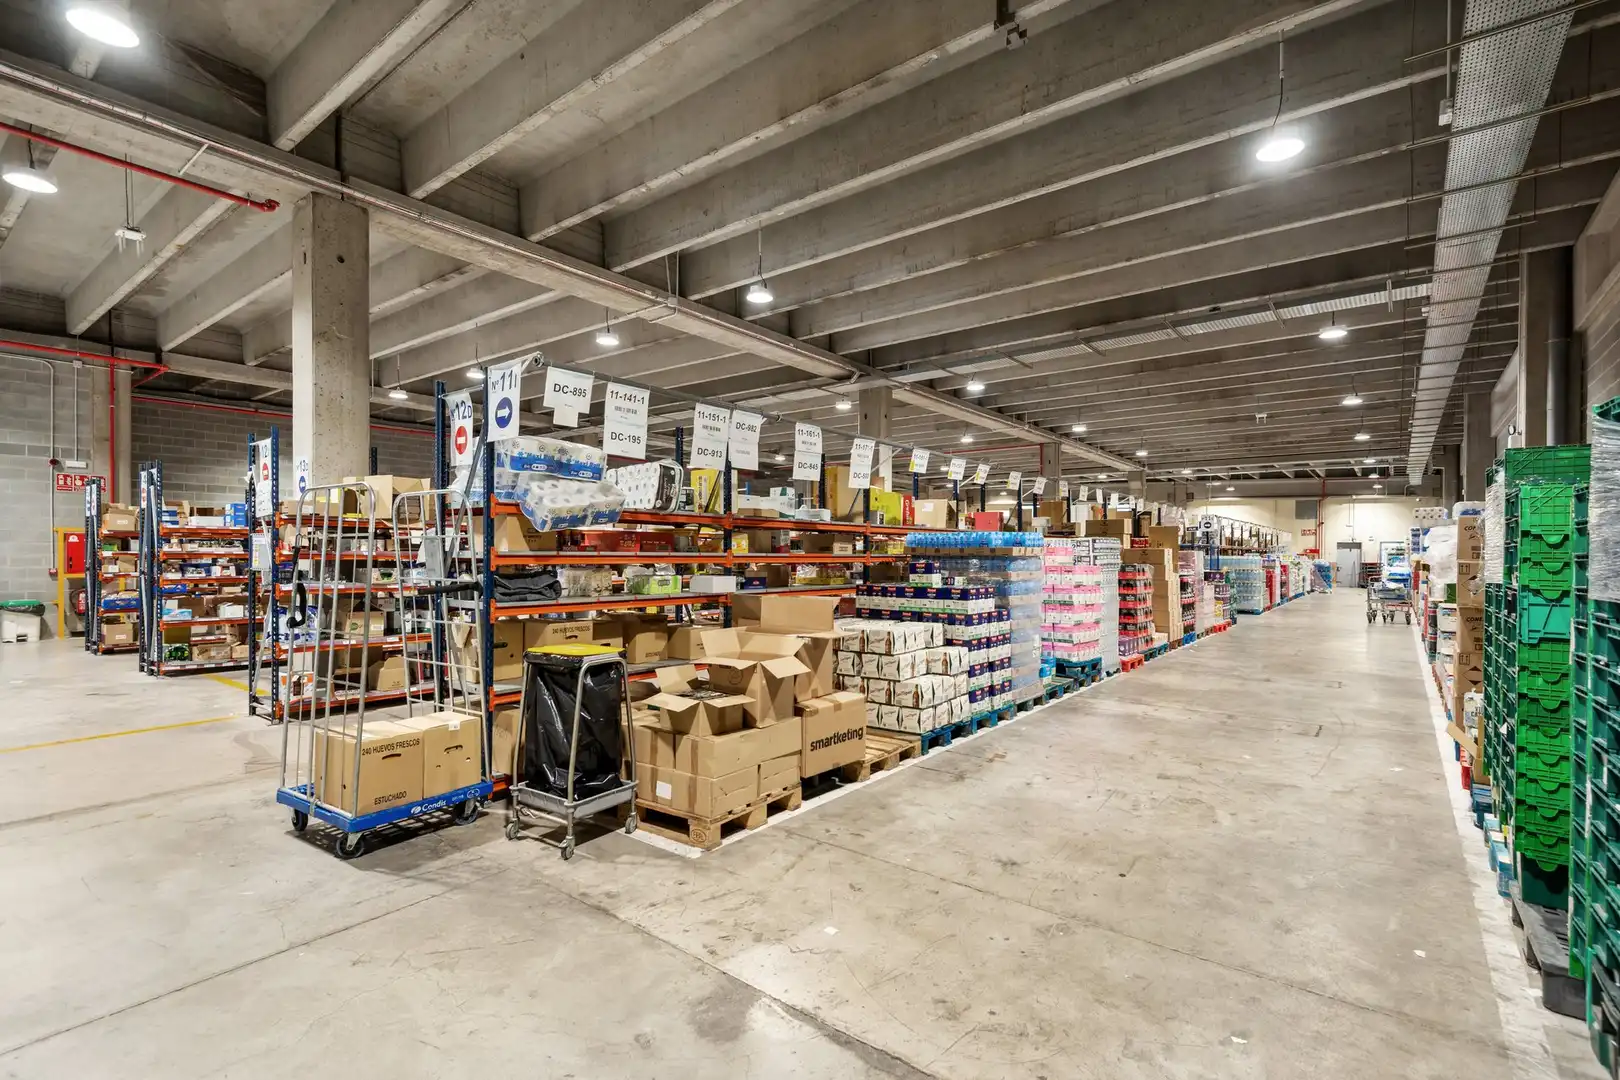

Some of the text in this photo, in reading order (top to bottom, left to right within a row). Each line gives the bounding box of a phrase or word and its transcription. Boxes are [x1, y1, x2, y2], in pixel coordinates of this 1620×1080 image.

[553, 383, 587, 398] DC-895
[609, 389, 645, 405] 11-141-1
[697, 410, 727, 424] 11-151-1
[610, 431, 641, 445] DC-195
[797, 428, 821, 439] 11-161-1
[696, 447, 723, 458] DC-913
[797, 461, 819, 470] DC-845
[810, 726, 864, 752] smartketing
[361, 737, 421, 756] 240 HUEVOS FRESCOS
[374, 790, 408, 806] ESTUCHADO
[421, 799, 447, 811] Condis
